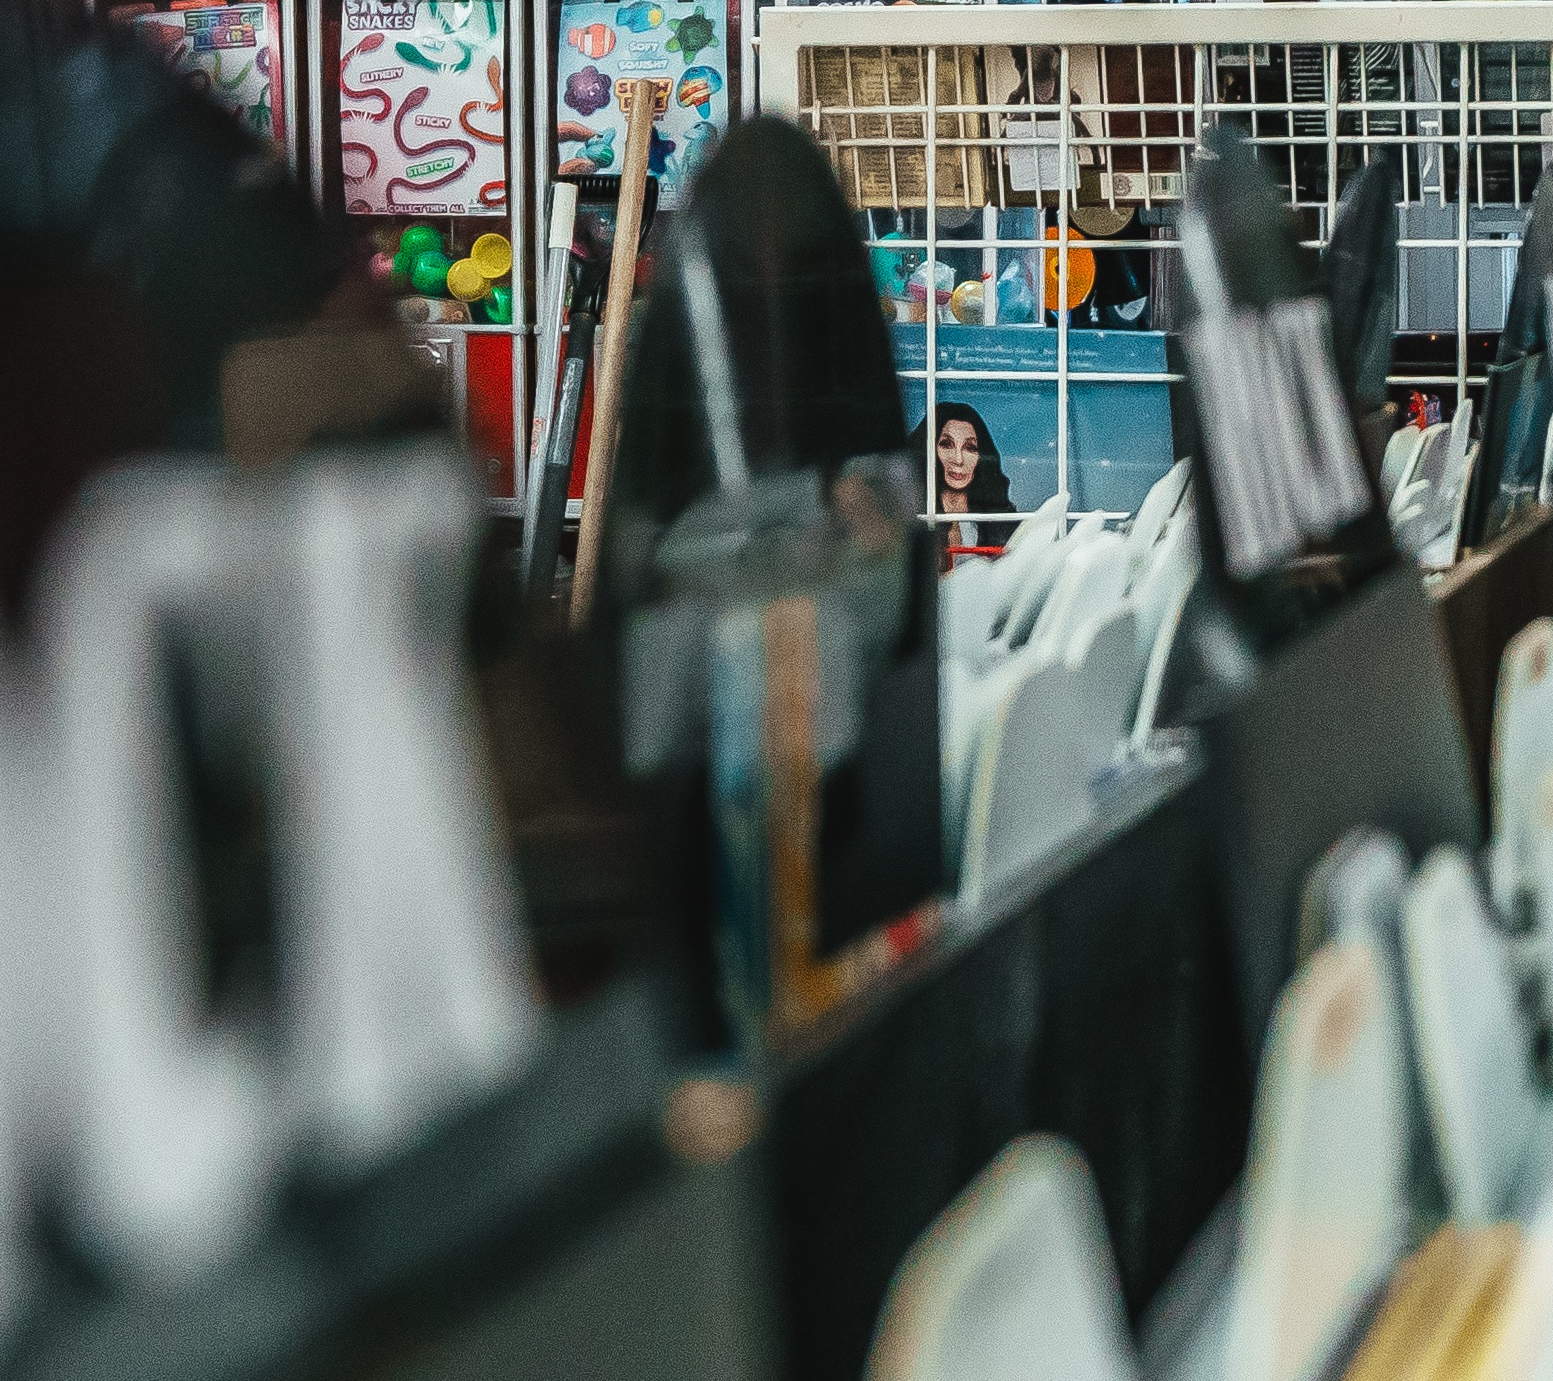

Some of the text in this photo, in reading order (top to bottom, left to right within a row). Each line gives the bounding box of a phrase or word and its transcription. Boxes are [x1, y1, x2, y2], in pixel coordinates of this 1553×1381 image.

[348, 14, 415, 30] SNAKES
[423, 36, 445, 49] NEW
[629, 41, 659, 53] SOFT
[360, 67, 404, 83] SLITHERY
[416, 116, 451, 128] STICKY
[406, 157, 455, 177] STRETCHY
[387, 204, 424, 214] COLLECT
[425, 204, 447, 214] THEM
[450, 204, 465, 214] ALL
